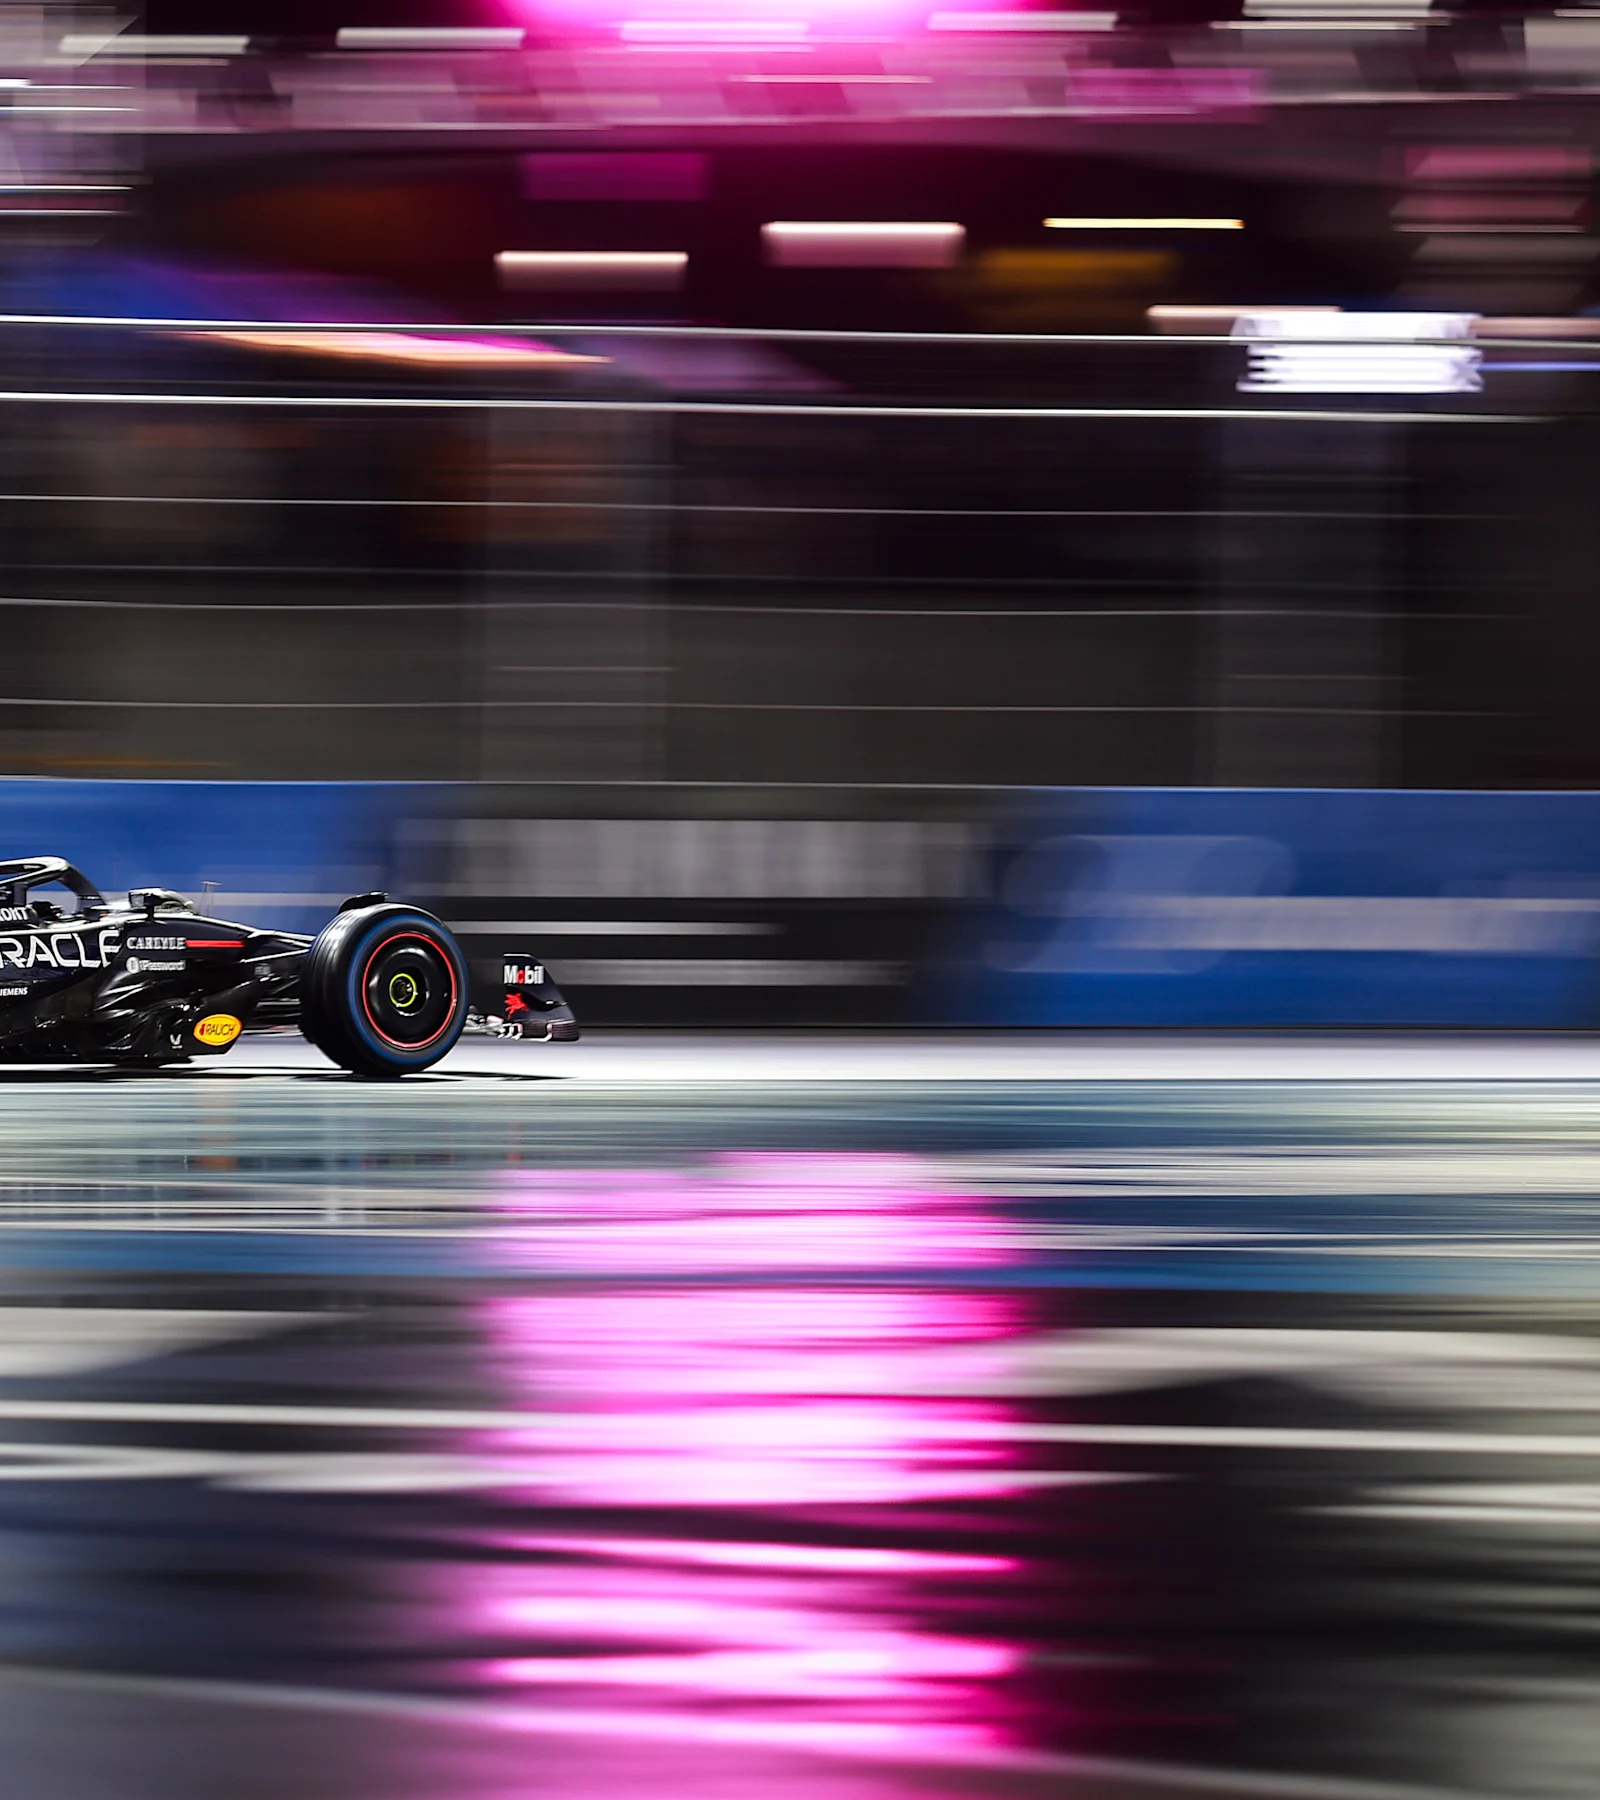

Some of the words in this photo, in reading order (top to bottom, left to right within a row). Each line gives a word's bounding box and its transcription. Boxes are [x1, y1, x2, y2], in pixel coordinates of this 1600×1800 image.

[126, 937, 187, 950] CARLYLE
[503, 965, 544, 985] Mobil
[206, 1024, 235, 1036] RAUCH
